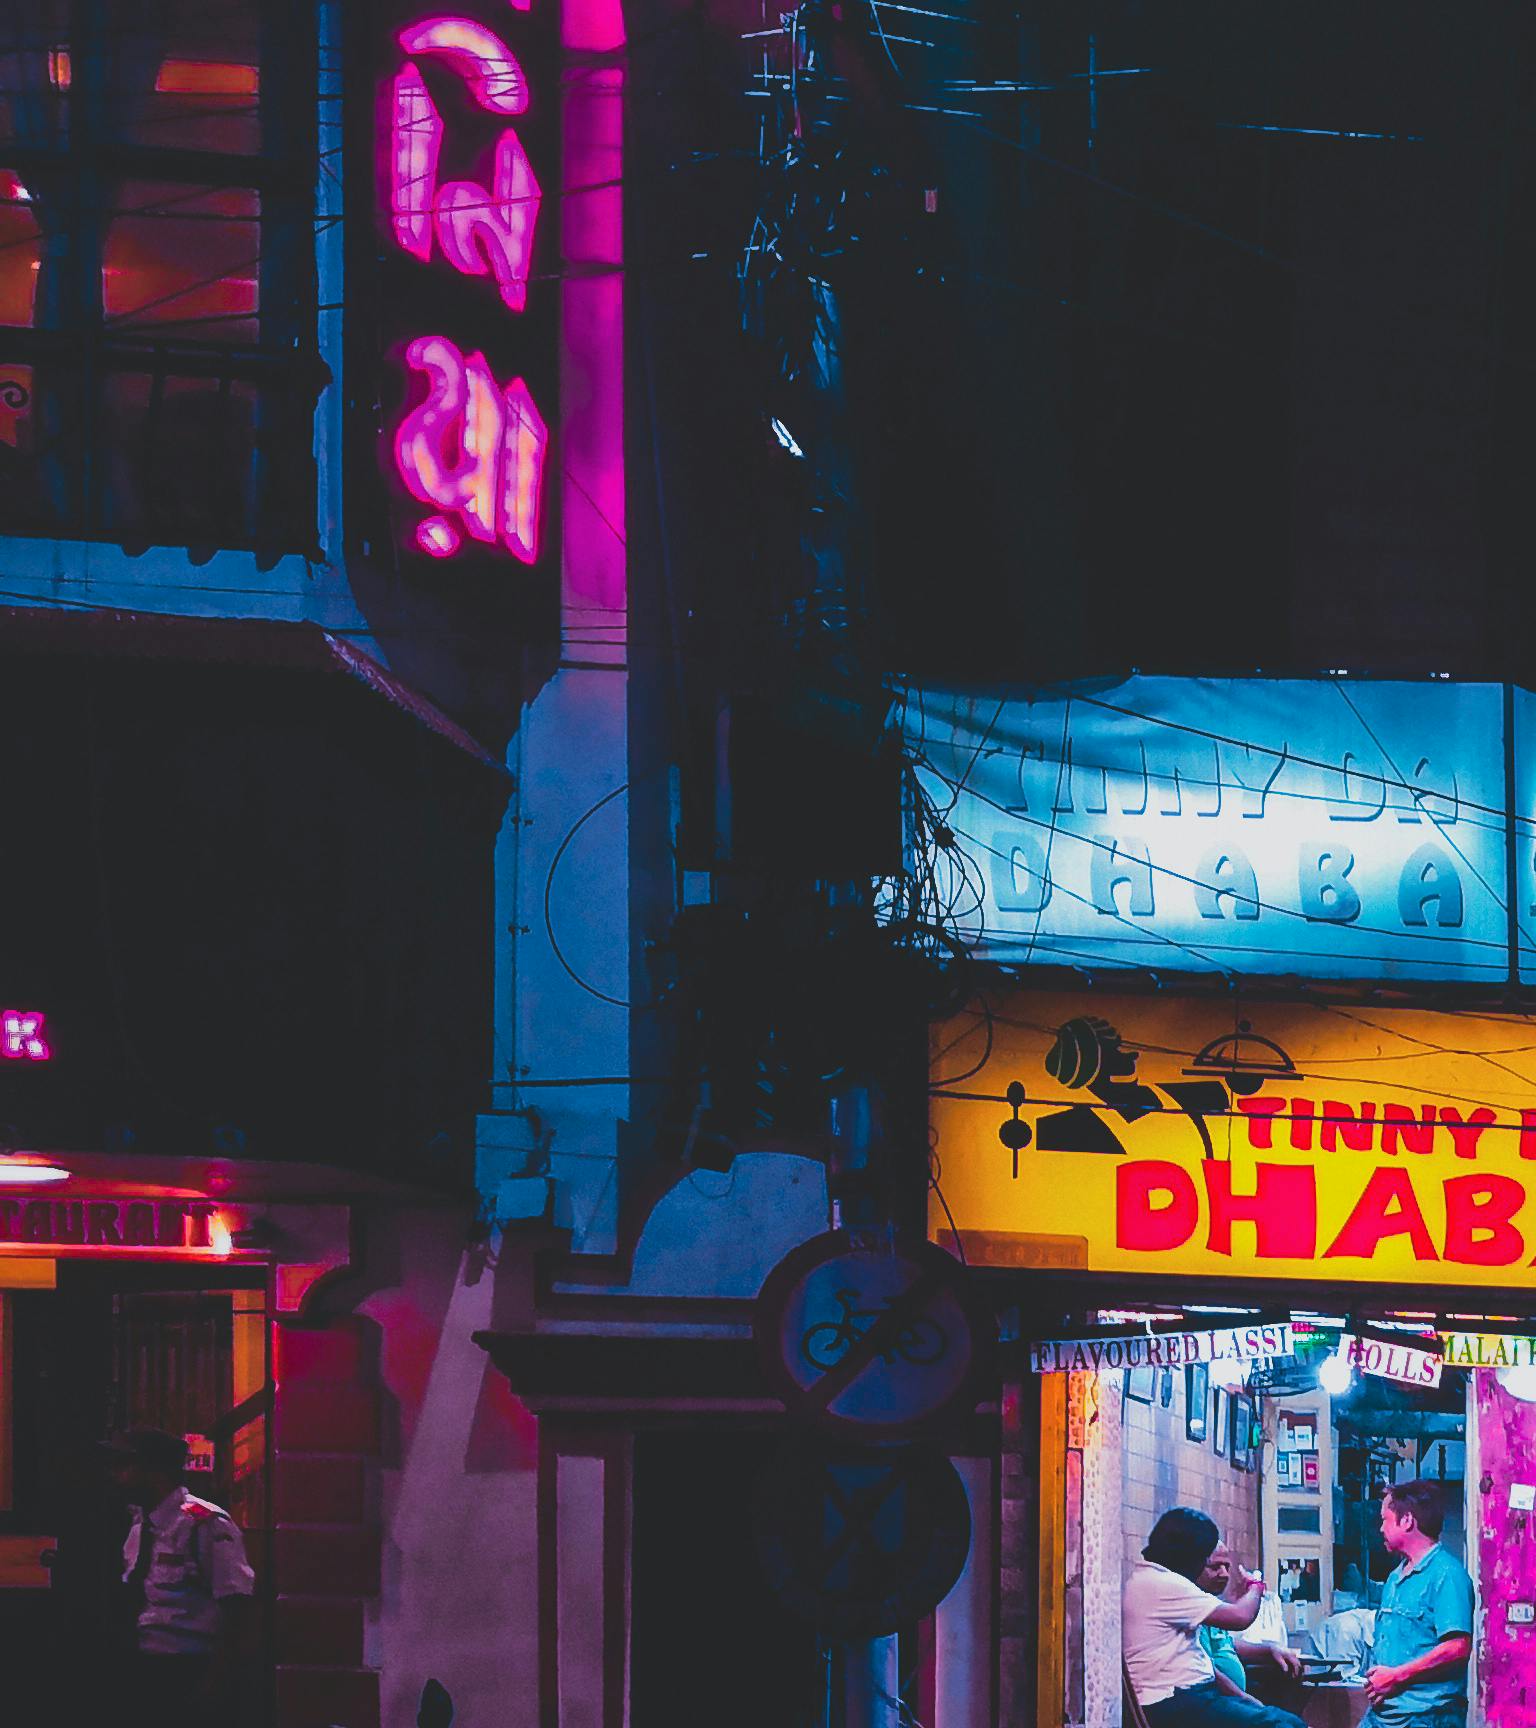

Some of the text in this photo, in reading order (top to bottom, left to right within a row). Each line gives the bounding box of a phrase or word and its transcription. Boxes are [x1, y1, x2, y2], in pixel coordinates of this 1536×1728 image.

[989, 830, 1465, 929] DHABA
[1237, 1096, 1497, 1159] TINNY
[1036, 1325, 1288, 1371] FLAVOURED LASSI
